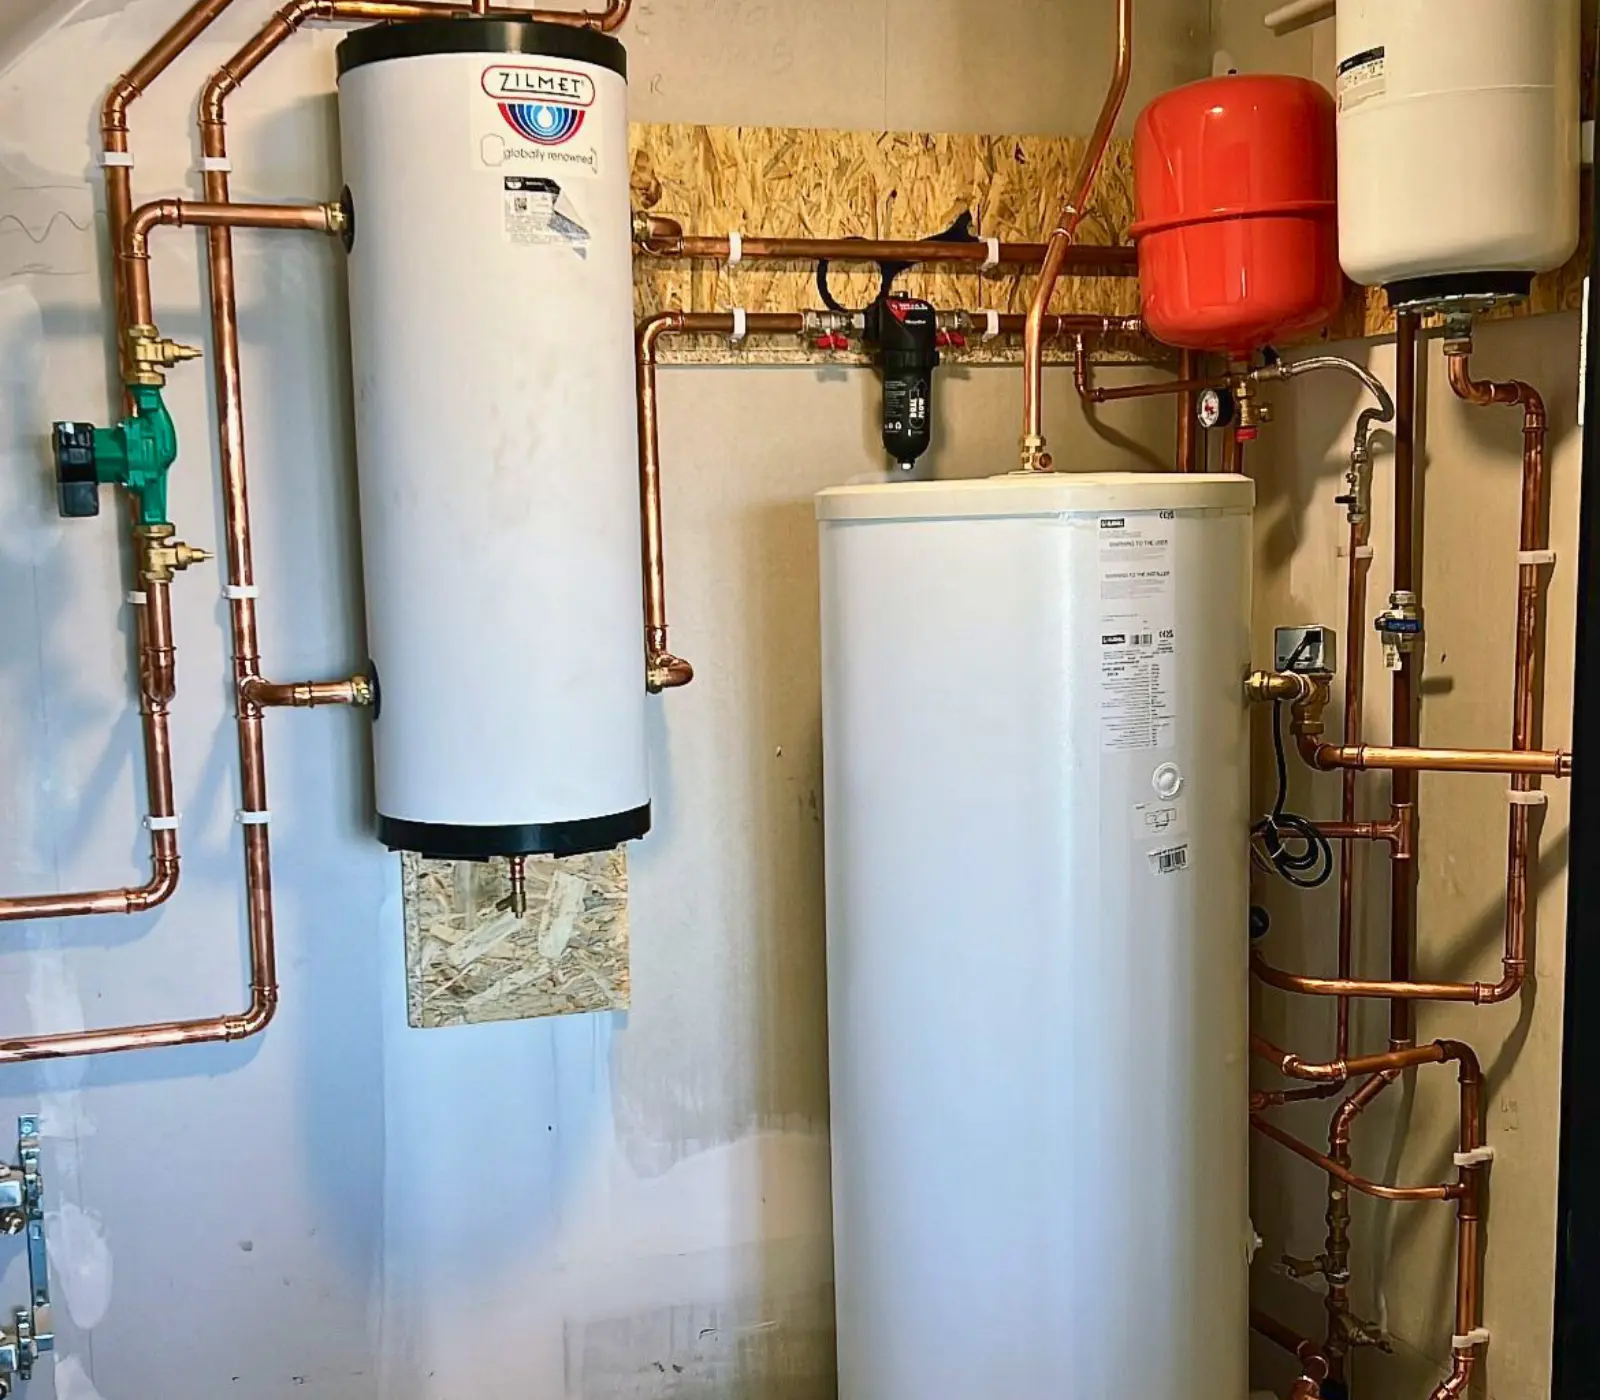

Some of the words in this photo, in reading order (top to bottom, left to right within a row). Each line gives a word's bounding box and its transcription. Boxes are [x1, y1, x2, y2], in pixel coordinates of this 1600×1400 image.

[499, 72, 581, 95] ZILMET
[503, 148, 545, 161] globally
[548, 151, 593, 165] renowned
